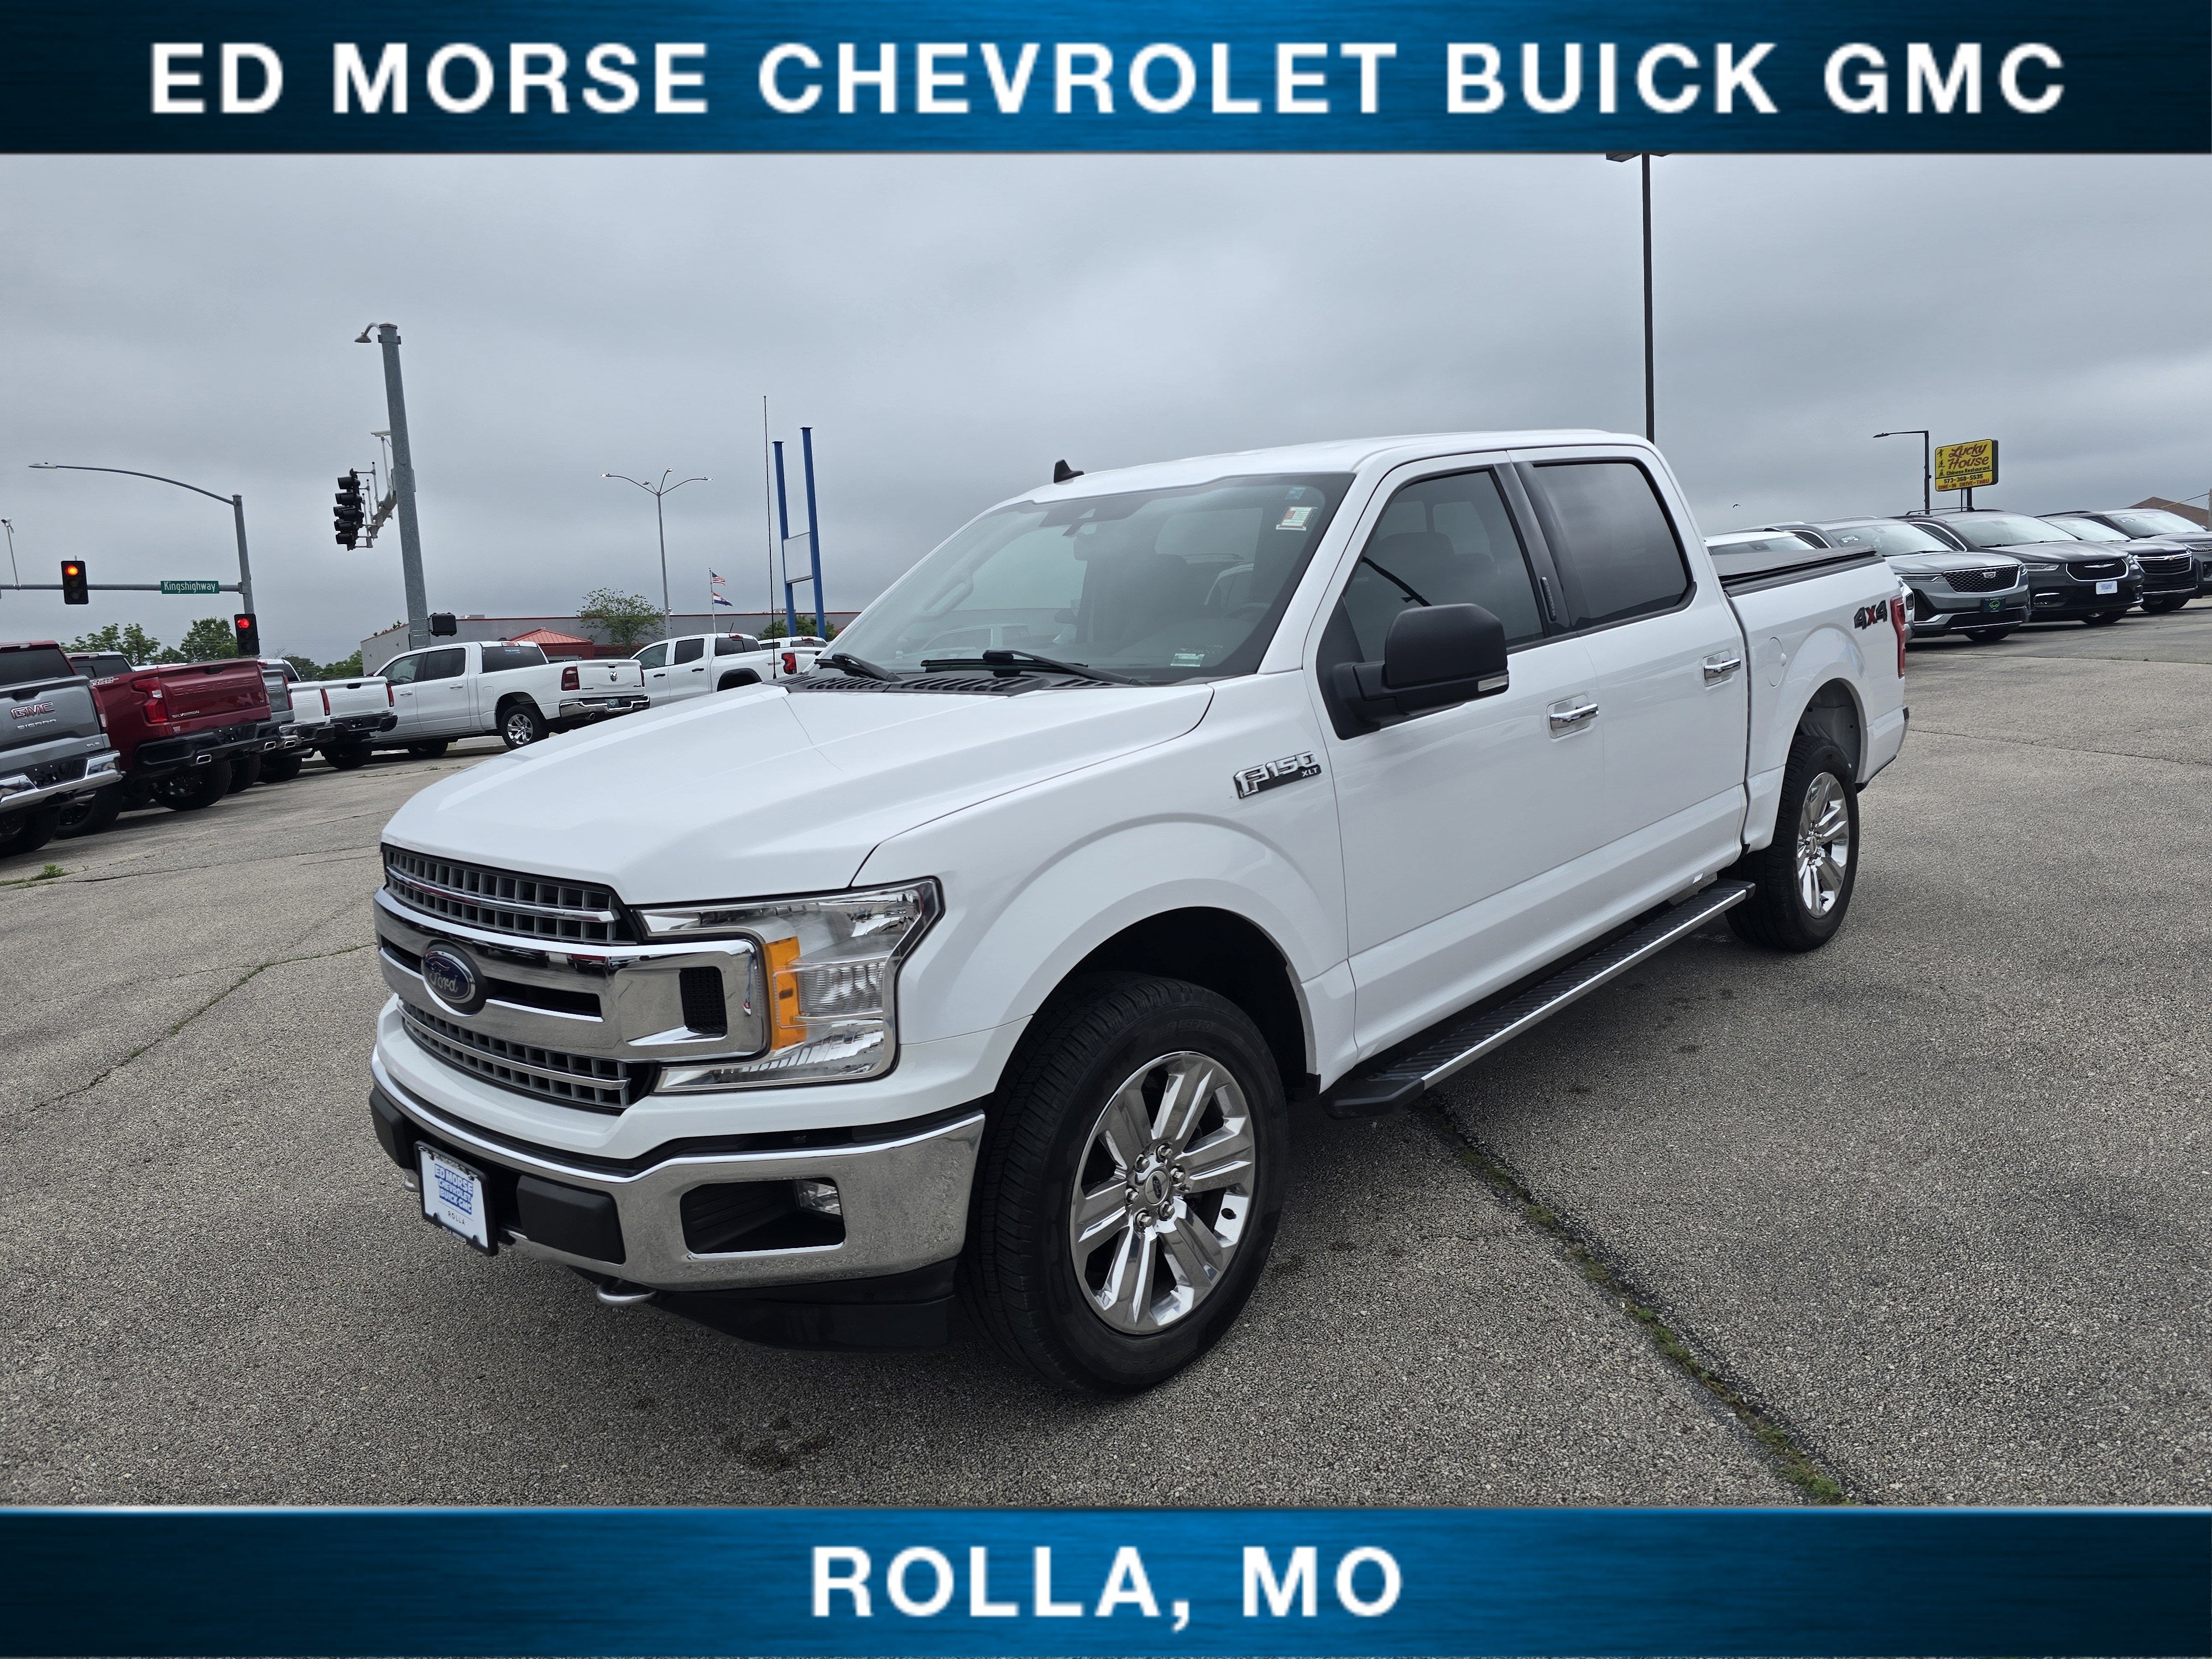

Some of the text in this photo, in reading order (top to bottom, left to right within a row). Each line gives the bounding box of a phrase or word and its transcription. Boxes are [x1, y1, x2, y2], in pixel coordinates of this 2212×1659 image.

[1949, 444, 1987, 458] Lucky
[1948, 456, 1989, 469] House
[164, 581, 216, 593] Kingshighway
[11, 701, 56, 719] GMC
[172, 710, 200, 718] SILVERADO
[17, 719, 56, 730] SIERRA
[1301, 767, 1318, 778] XLT
[429, 961, 459, 993] Ford
[435, 1164, 473, 1197] ED MORSE
[439, 1178, 472, 1203] CHEVROLET
[447, 1211, 466, 1226] ROLLA
